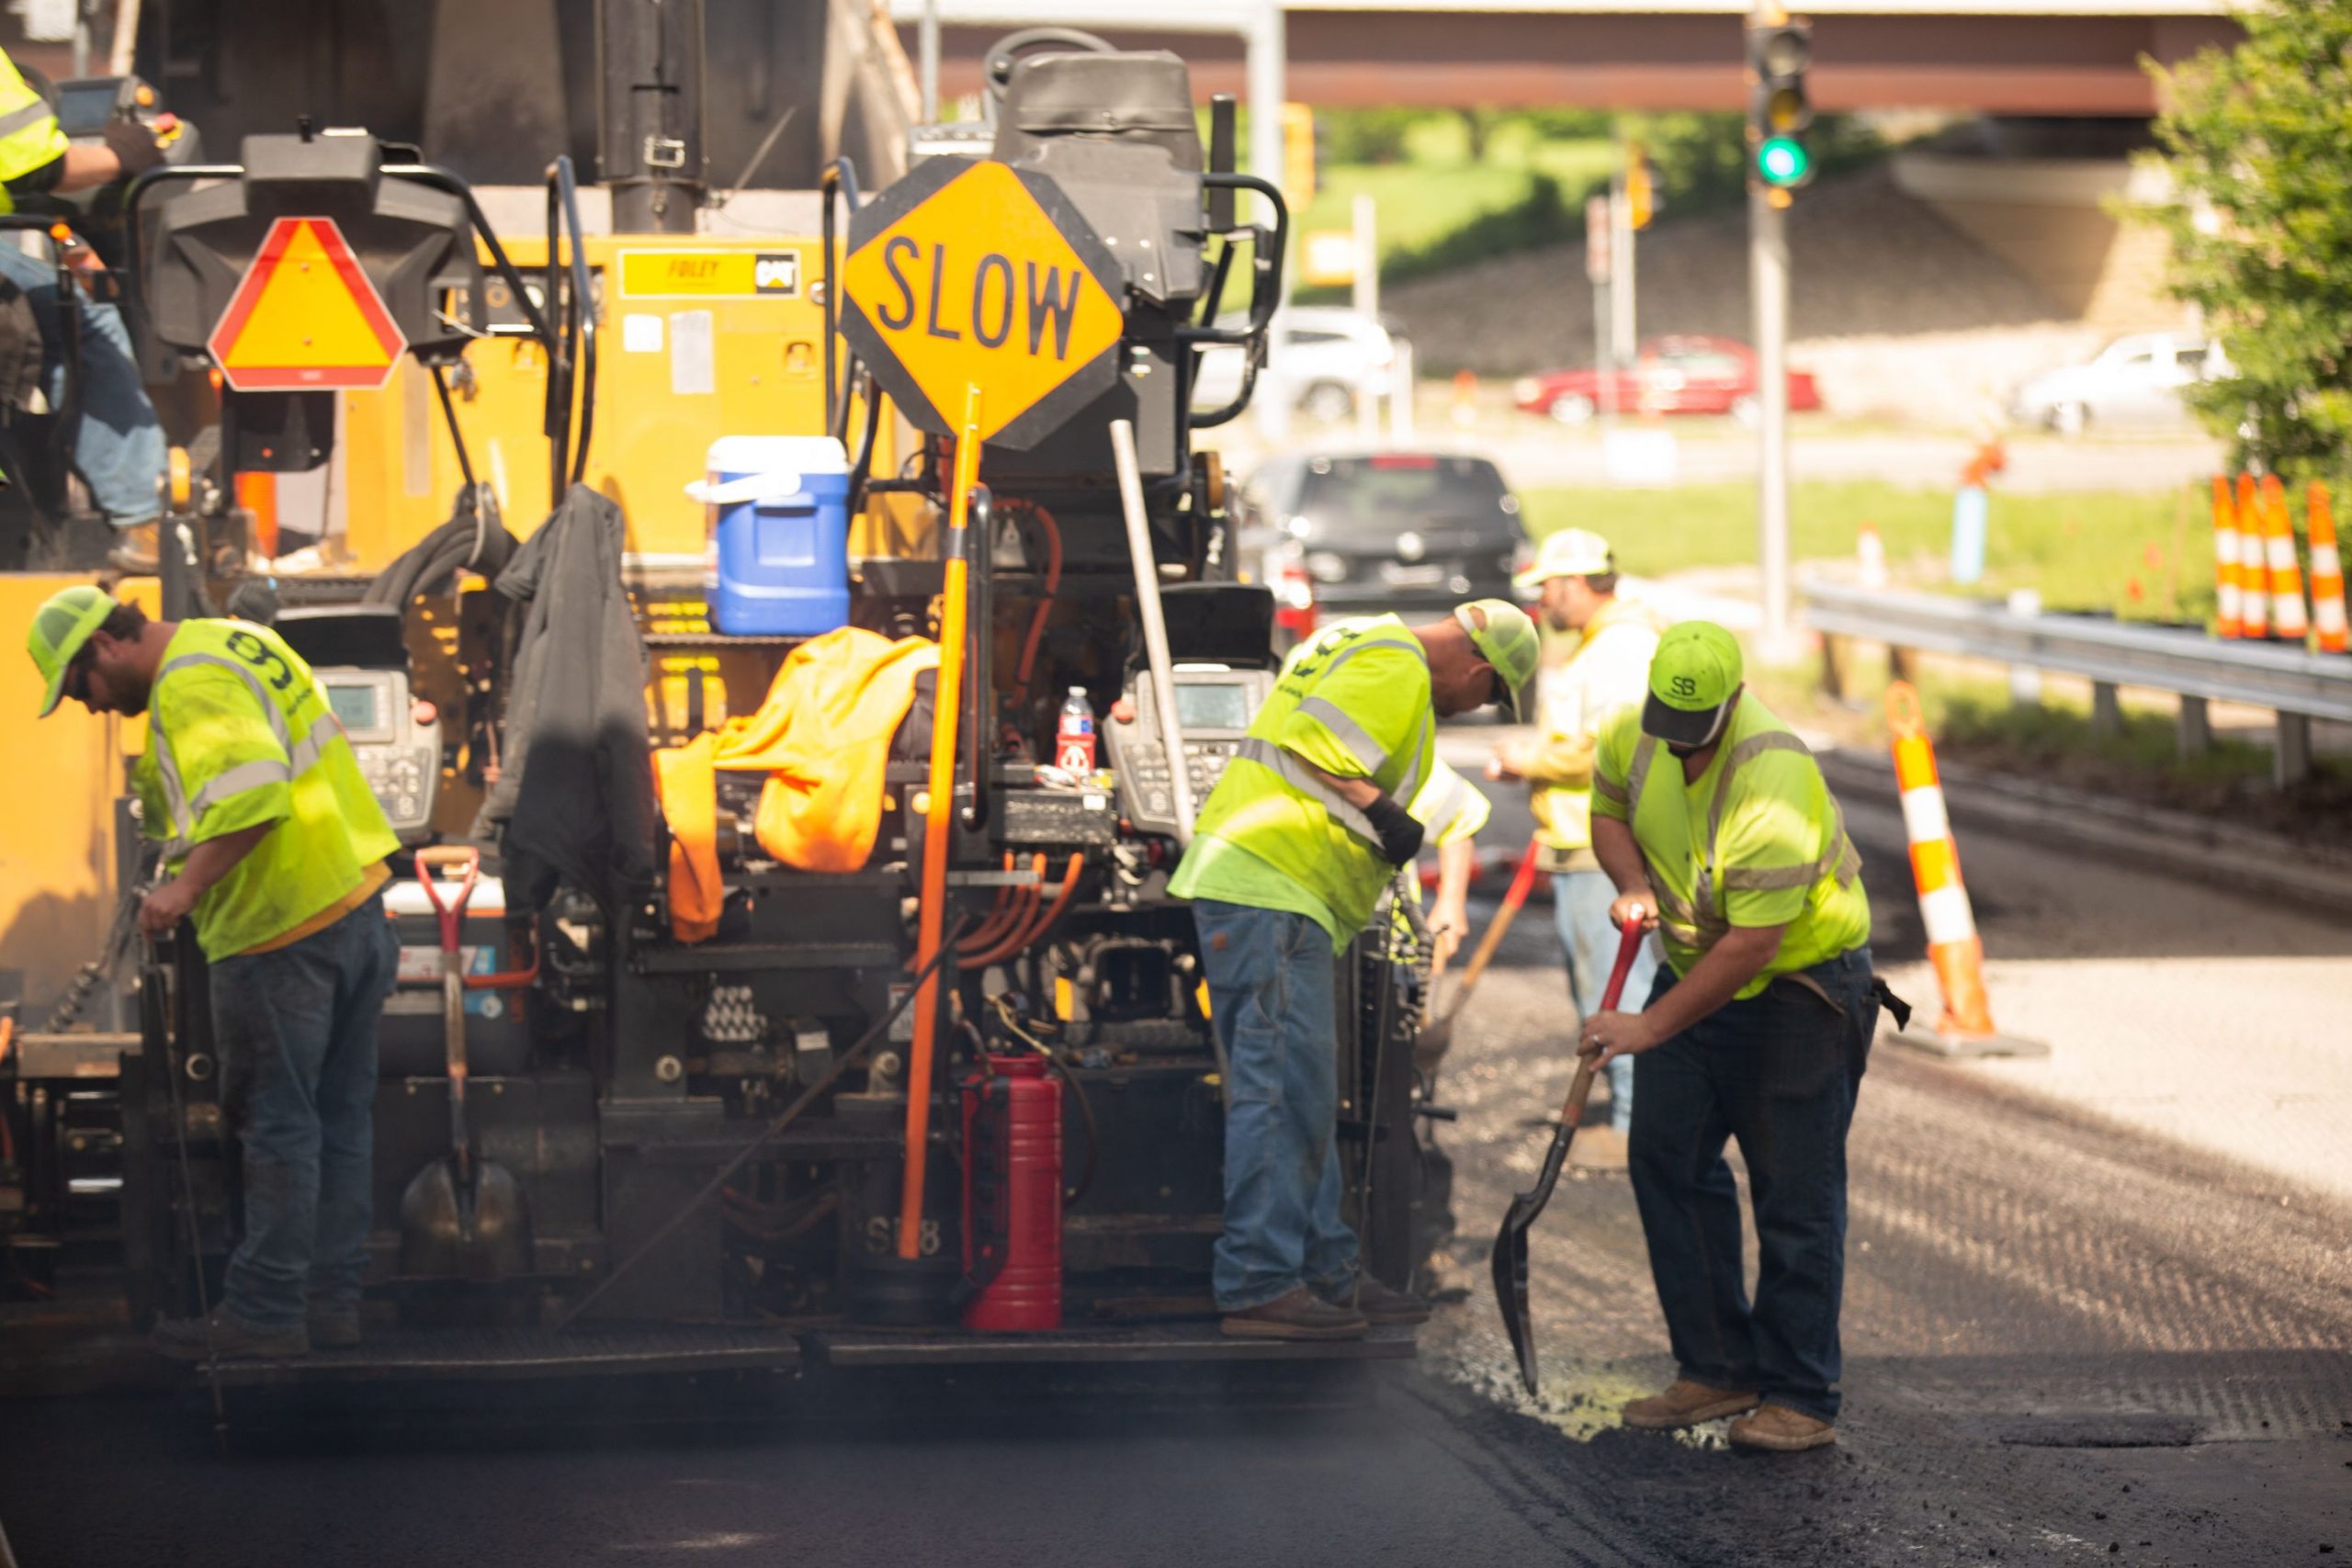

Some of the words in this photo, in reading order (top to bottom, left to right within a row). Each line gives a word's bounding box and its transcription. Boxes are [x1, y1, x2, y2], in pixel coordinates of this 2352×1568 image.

[668, 259, 719, 278] FOLEY
[755, 260, 794, 288] CAT
[876, 235, 1082, 362] SLOW
[1671, 676, 1696, 695] SB
[866, 1215, 941, 1256] S8
